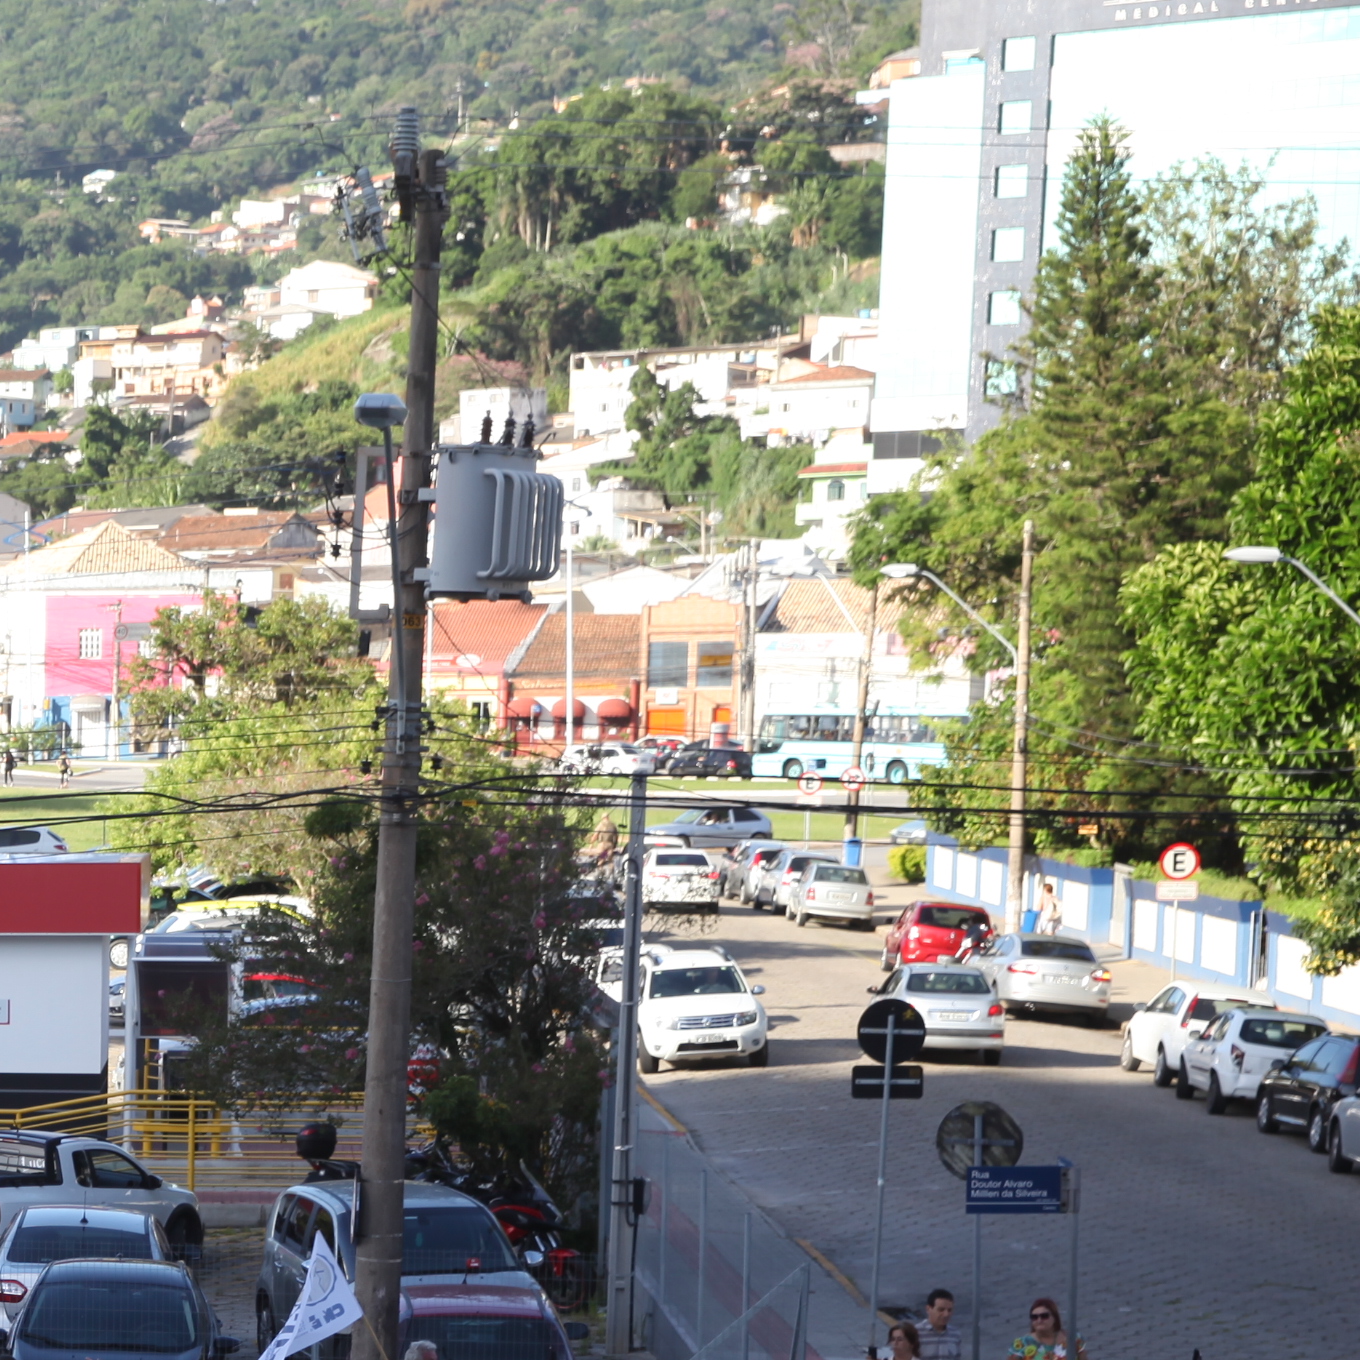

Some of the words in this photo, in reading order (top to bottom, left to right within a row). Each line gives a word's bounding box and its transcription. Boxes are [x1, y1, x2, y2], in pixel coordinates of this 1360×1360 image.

[1114, 1, 1220, 21] MEDICAL
[1173, 852, 1187, 872] E
[970, 1170, 991, 1179] Rua
[970, 1179, 1002, 1189] Doutor
[1001, 1189, 1014, 1198] da
[1015, 1189, 1048, 1198] Silveira
